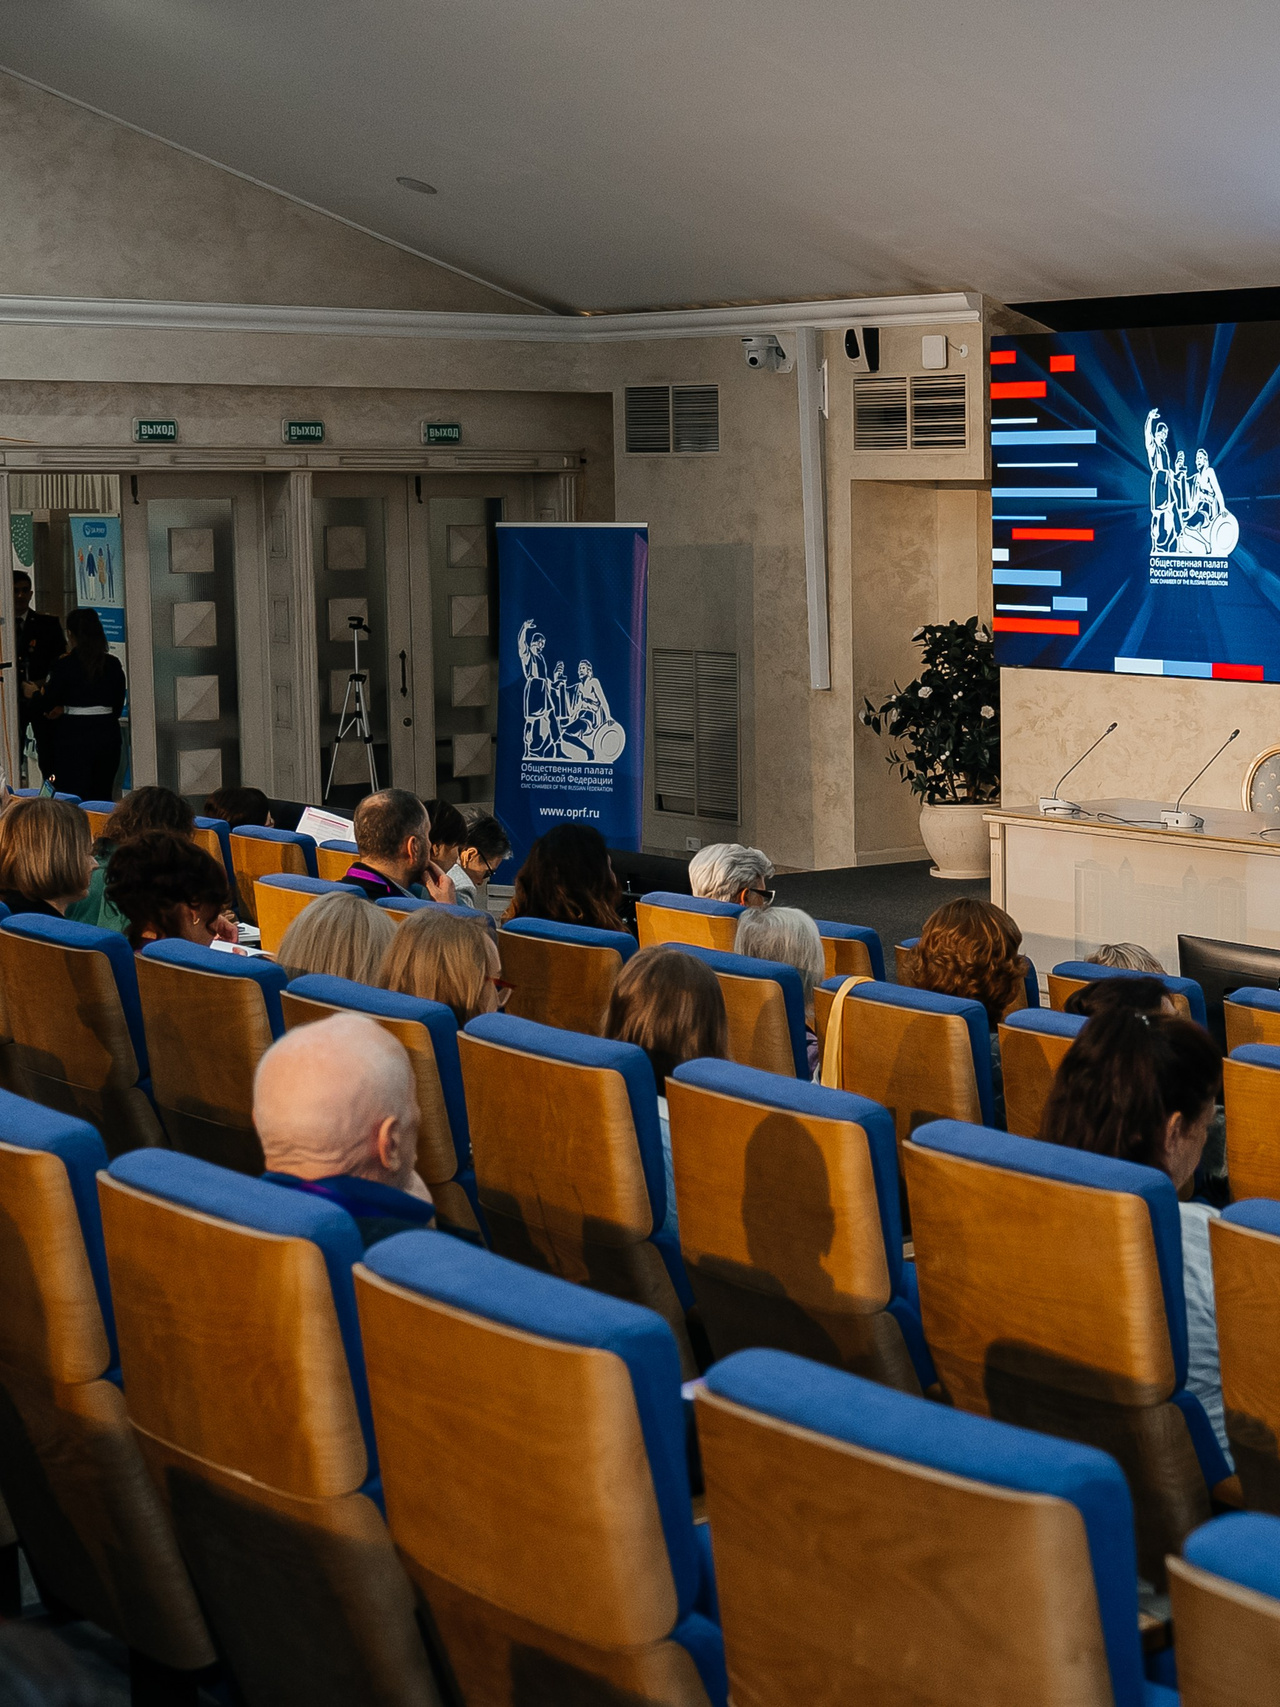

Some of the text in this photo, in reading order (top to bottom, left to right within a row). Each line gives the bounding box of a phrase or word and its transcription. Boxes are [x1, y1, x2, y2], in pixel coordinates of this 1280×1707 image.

[141, 425, 175, 436] ВЫХОД
[290, 425, 323, 437] ВЫХОД
[429, 427, 459, 438] ВЫХОД
[1149, 558, 1229, 568] Общественная палата
[1149, 568, 1228, 580] Российской Федерации
[521, 763, 614, 775] Общественная палата
[521, 773, 613, 786] Российской Федерации
[539, 807, 600, 820] www.oprf.ru
